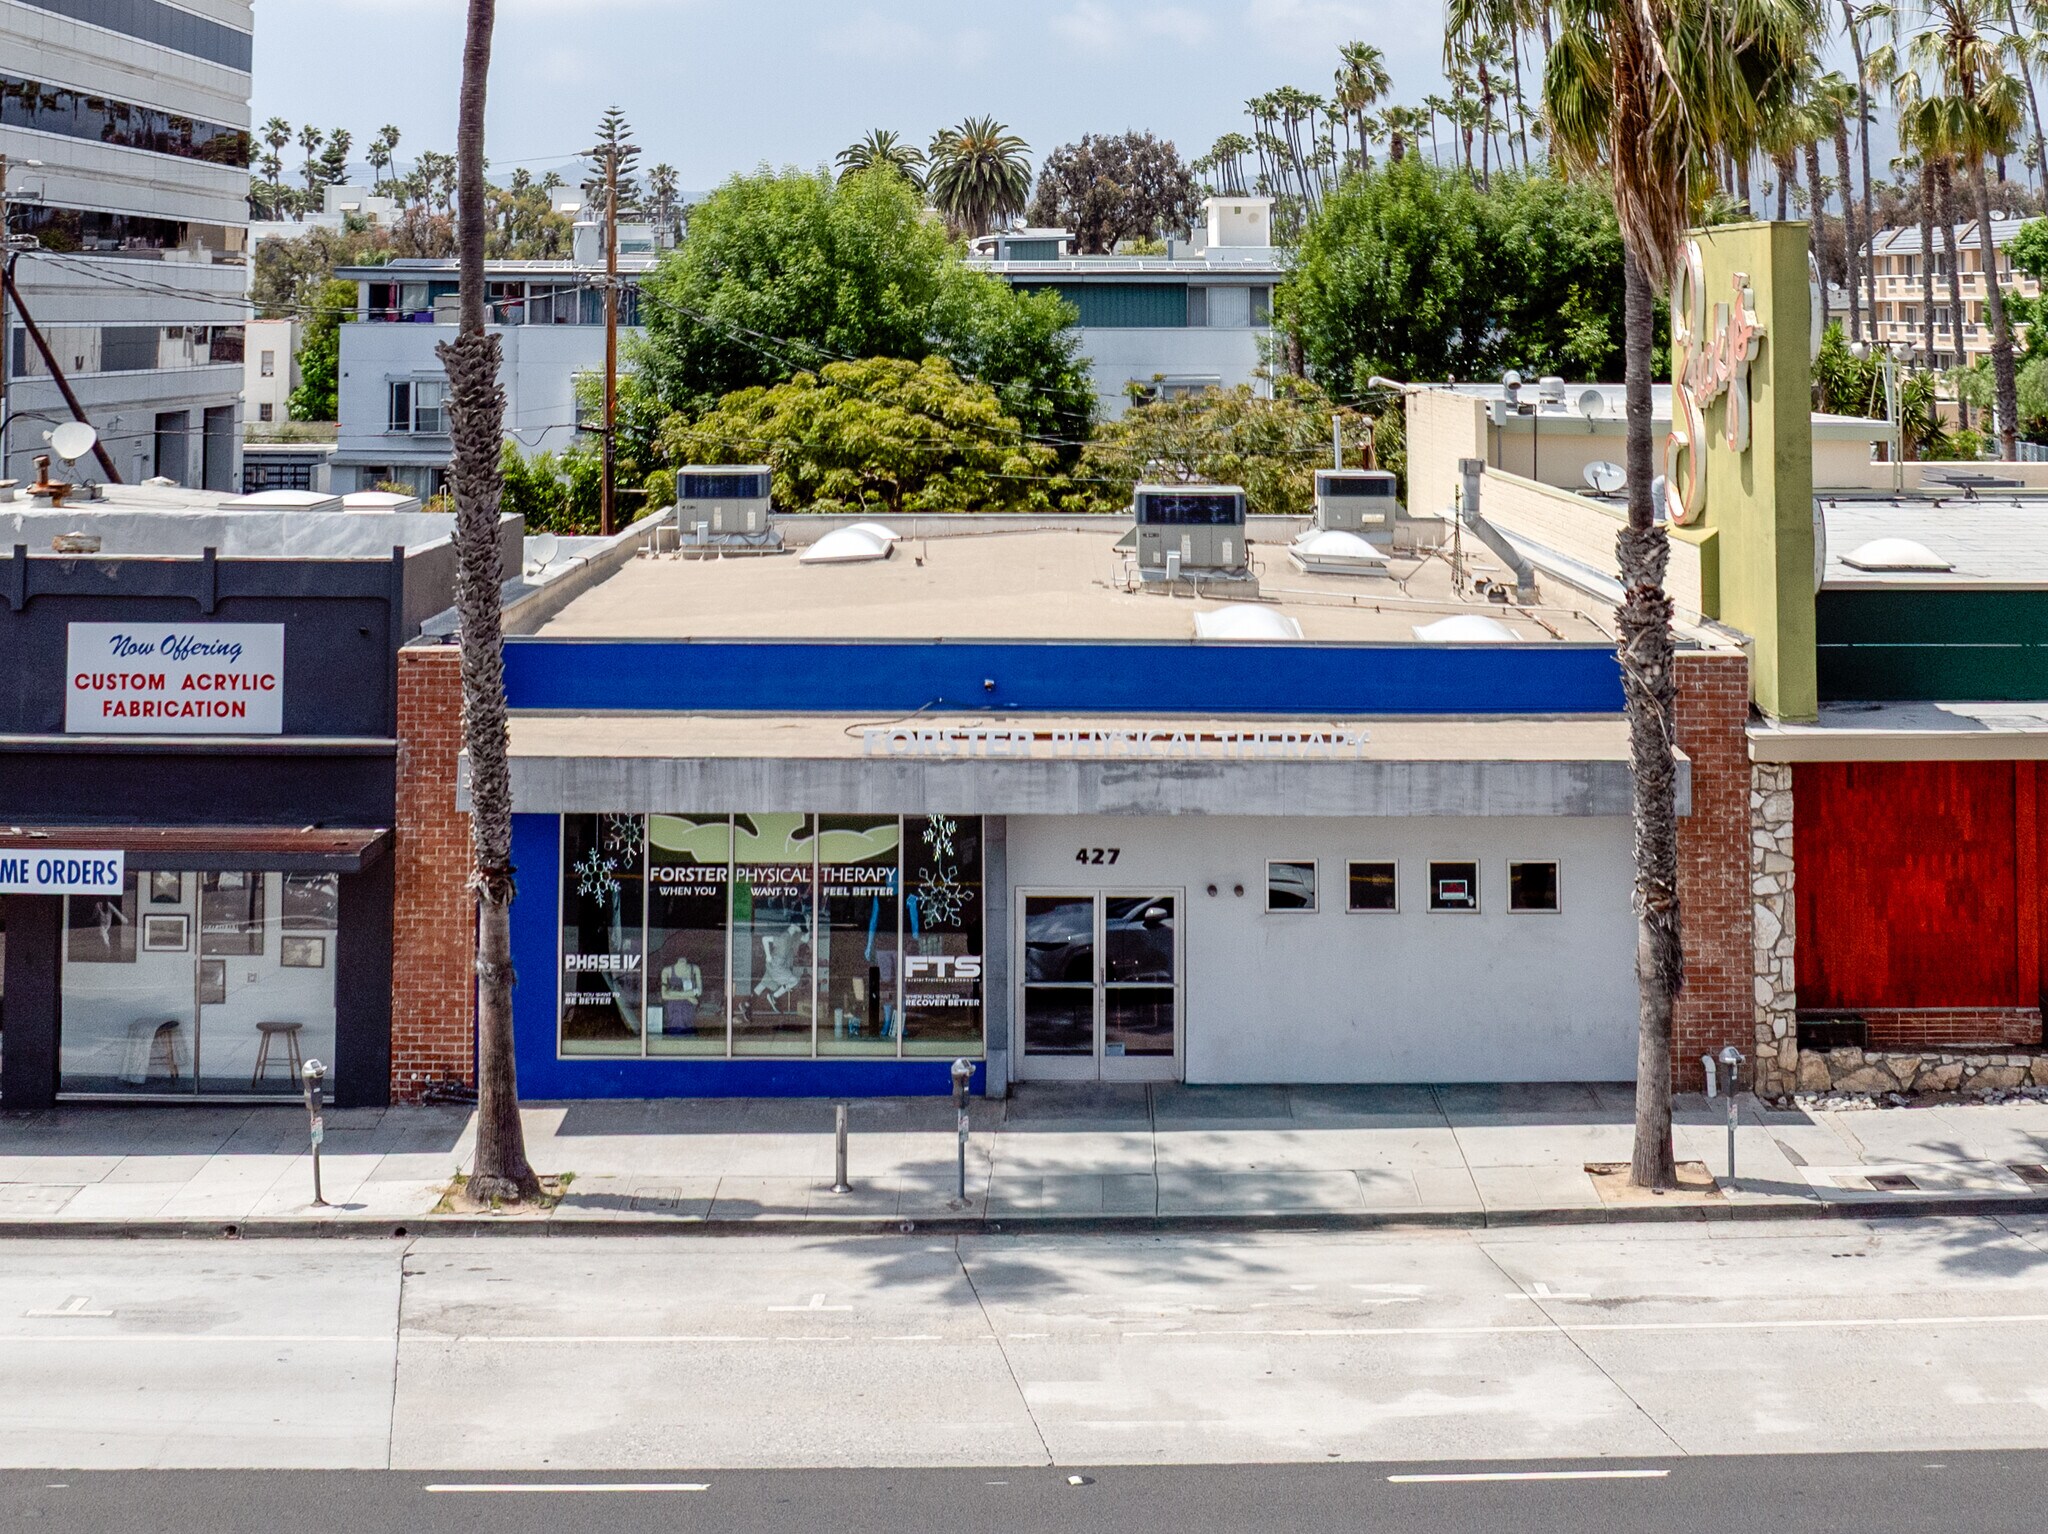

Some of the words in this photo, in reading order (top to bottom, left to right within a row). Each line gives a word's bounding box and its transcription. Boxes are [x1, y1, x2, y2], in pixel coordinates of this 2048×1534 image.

[109, 634, 155, 658] Now
[160, 634, 243, 664] Offering
[74, 673, 165, 690] CUSTOM
[181, 673, 276, 691] ACRYLIC
[102, 700, 246, 718] FABRICATION
[863, 729, 1034, 756] FORSTER
[1052, 729, 1205, 757] PHYSICAL
[1214, 730, 1371, 758] THERAPY
[1075, 848, 1120, 865] 427
[36, 859, 118, 885] ORDERS
[649, 867, 727, 882] FORSTER
[736, 867, 811, 883] PHYSICAL
[821, 867, 897, 883] THERAPY
[659, 886, 692, 896] WHEN
[694, 886, 716, 896] YOU
[750, 886, 781, 897] WANT
[782, 887, 798, 897] TO
[823, 887, 850, 896] FEEL
[852, 887, 894, 896] BETTER
[565, 954, 620, 969] PHASE
[623, 954, 641, 969] IV
[905, 956, 981, 978] FTS
[565, 997, 577, 1005] BE
[579, 997, 612, 1005] BETTER
[905, 999, 946, 1007] RECOVER
[948, 999, 980, 1007] BETTER
